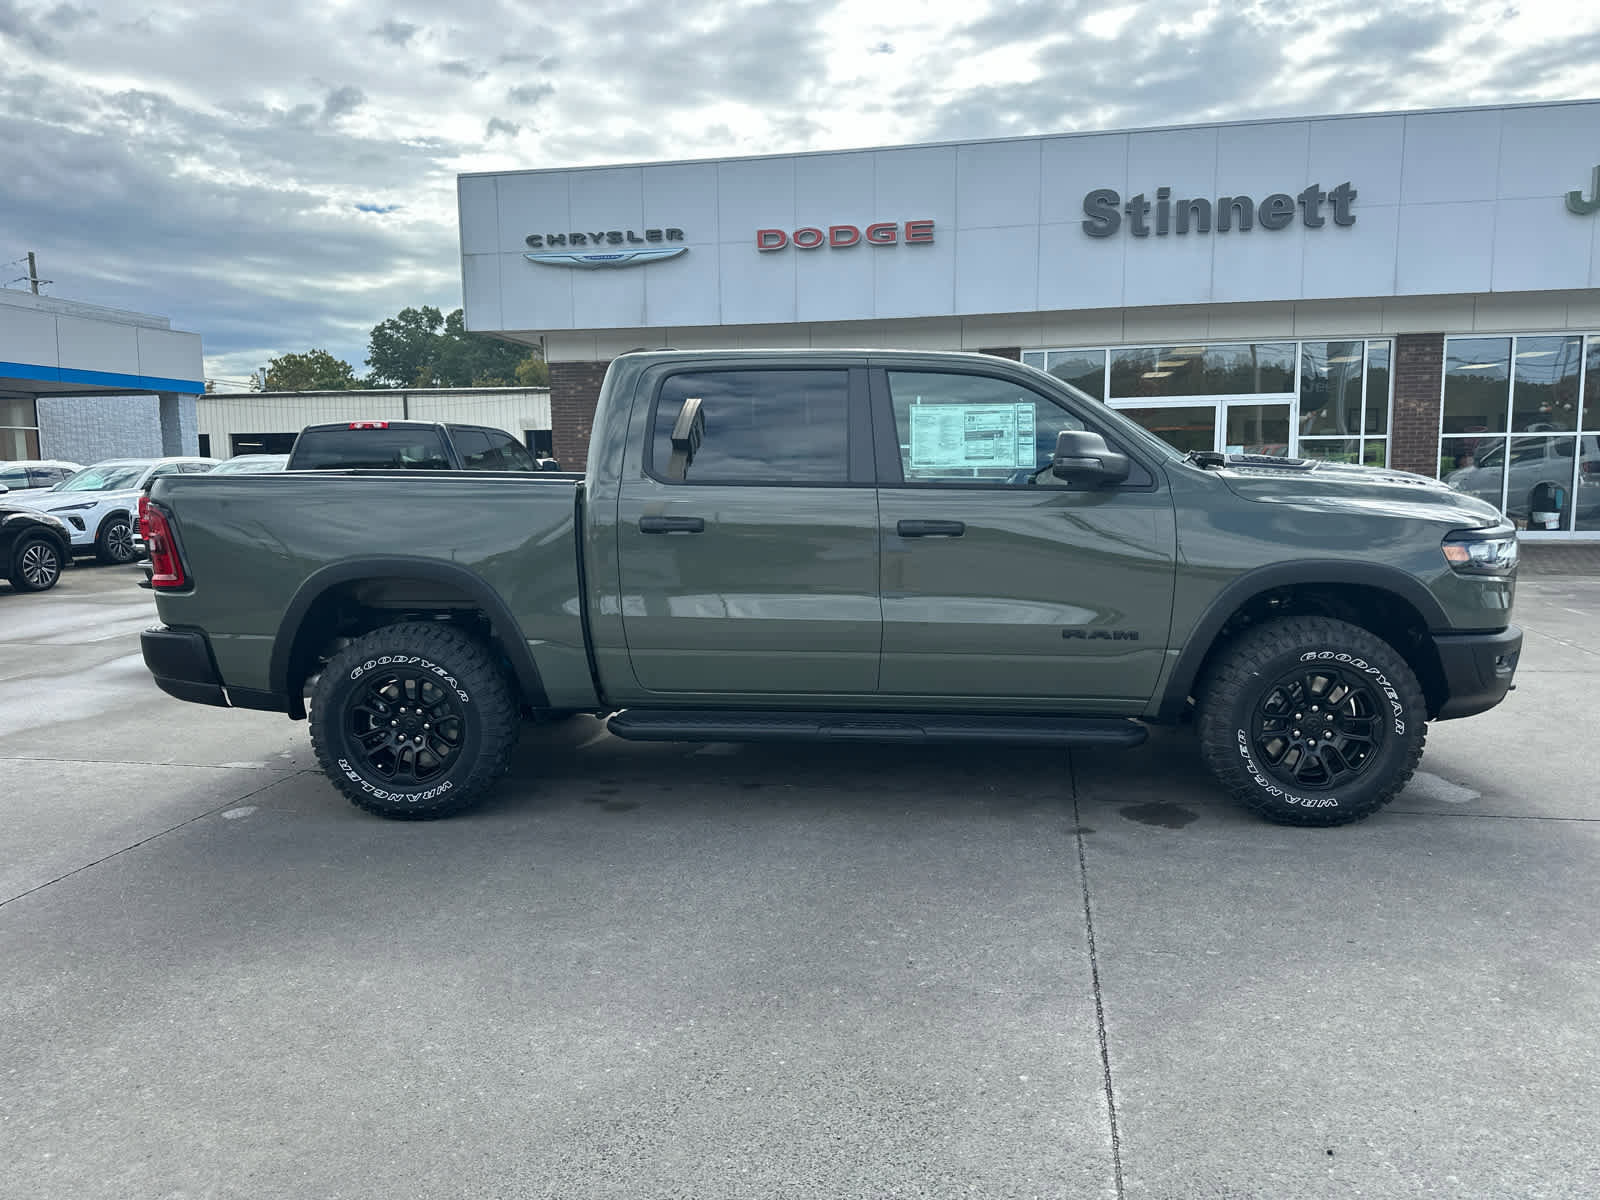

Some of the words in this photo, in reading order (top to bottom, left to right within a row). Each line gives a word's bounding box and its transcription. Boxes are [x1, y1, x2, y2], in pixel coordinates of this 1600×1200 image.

[1083, 182, 1358, 238] Stinnett
[526, 228, 684, 248] CHRYSLER
[757, 220, 935, 252] DODGE
[1062, 629, 1139, 641] RAM
[351, 655, 469, 702] GOODYEAR
[1300, 651, 1405, 735] GOODYEAR
[338, 758, 453, 802] WRANGLER
[1237, 729, 1338, 808] WRANGLER
